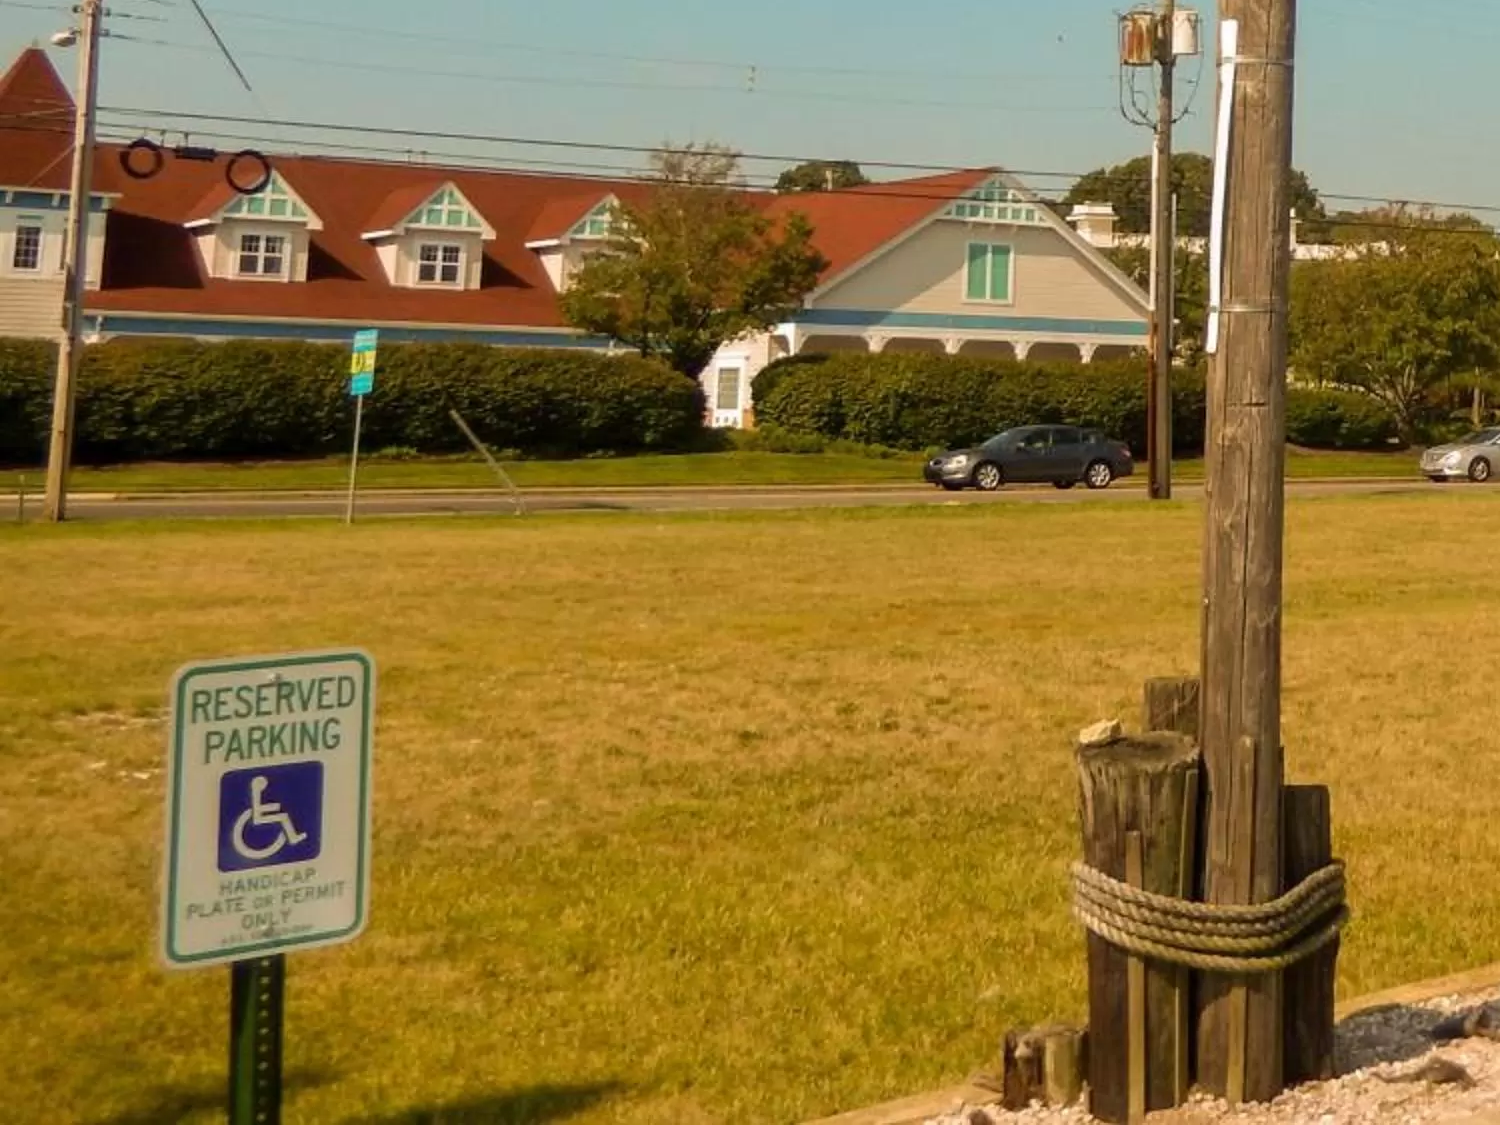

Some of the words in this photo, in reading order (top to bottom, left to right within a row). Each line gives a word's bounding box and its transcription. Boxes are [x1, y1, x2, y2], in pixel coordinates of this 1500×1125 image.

[190, 675, 356, 724] RESERVED
[203, 718, 341, 765] PARKING
[186, 896, 245, 920] PLATE
[280, 881, 345, 905] PERMIT
[218, 867, 317, 896] HANDICAP
[240, 908, 292, 930] ONLY
